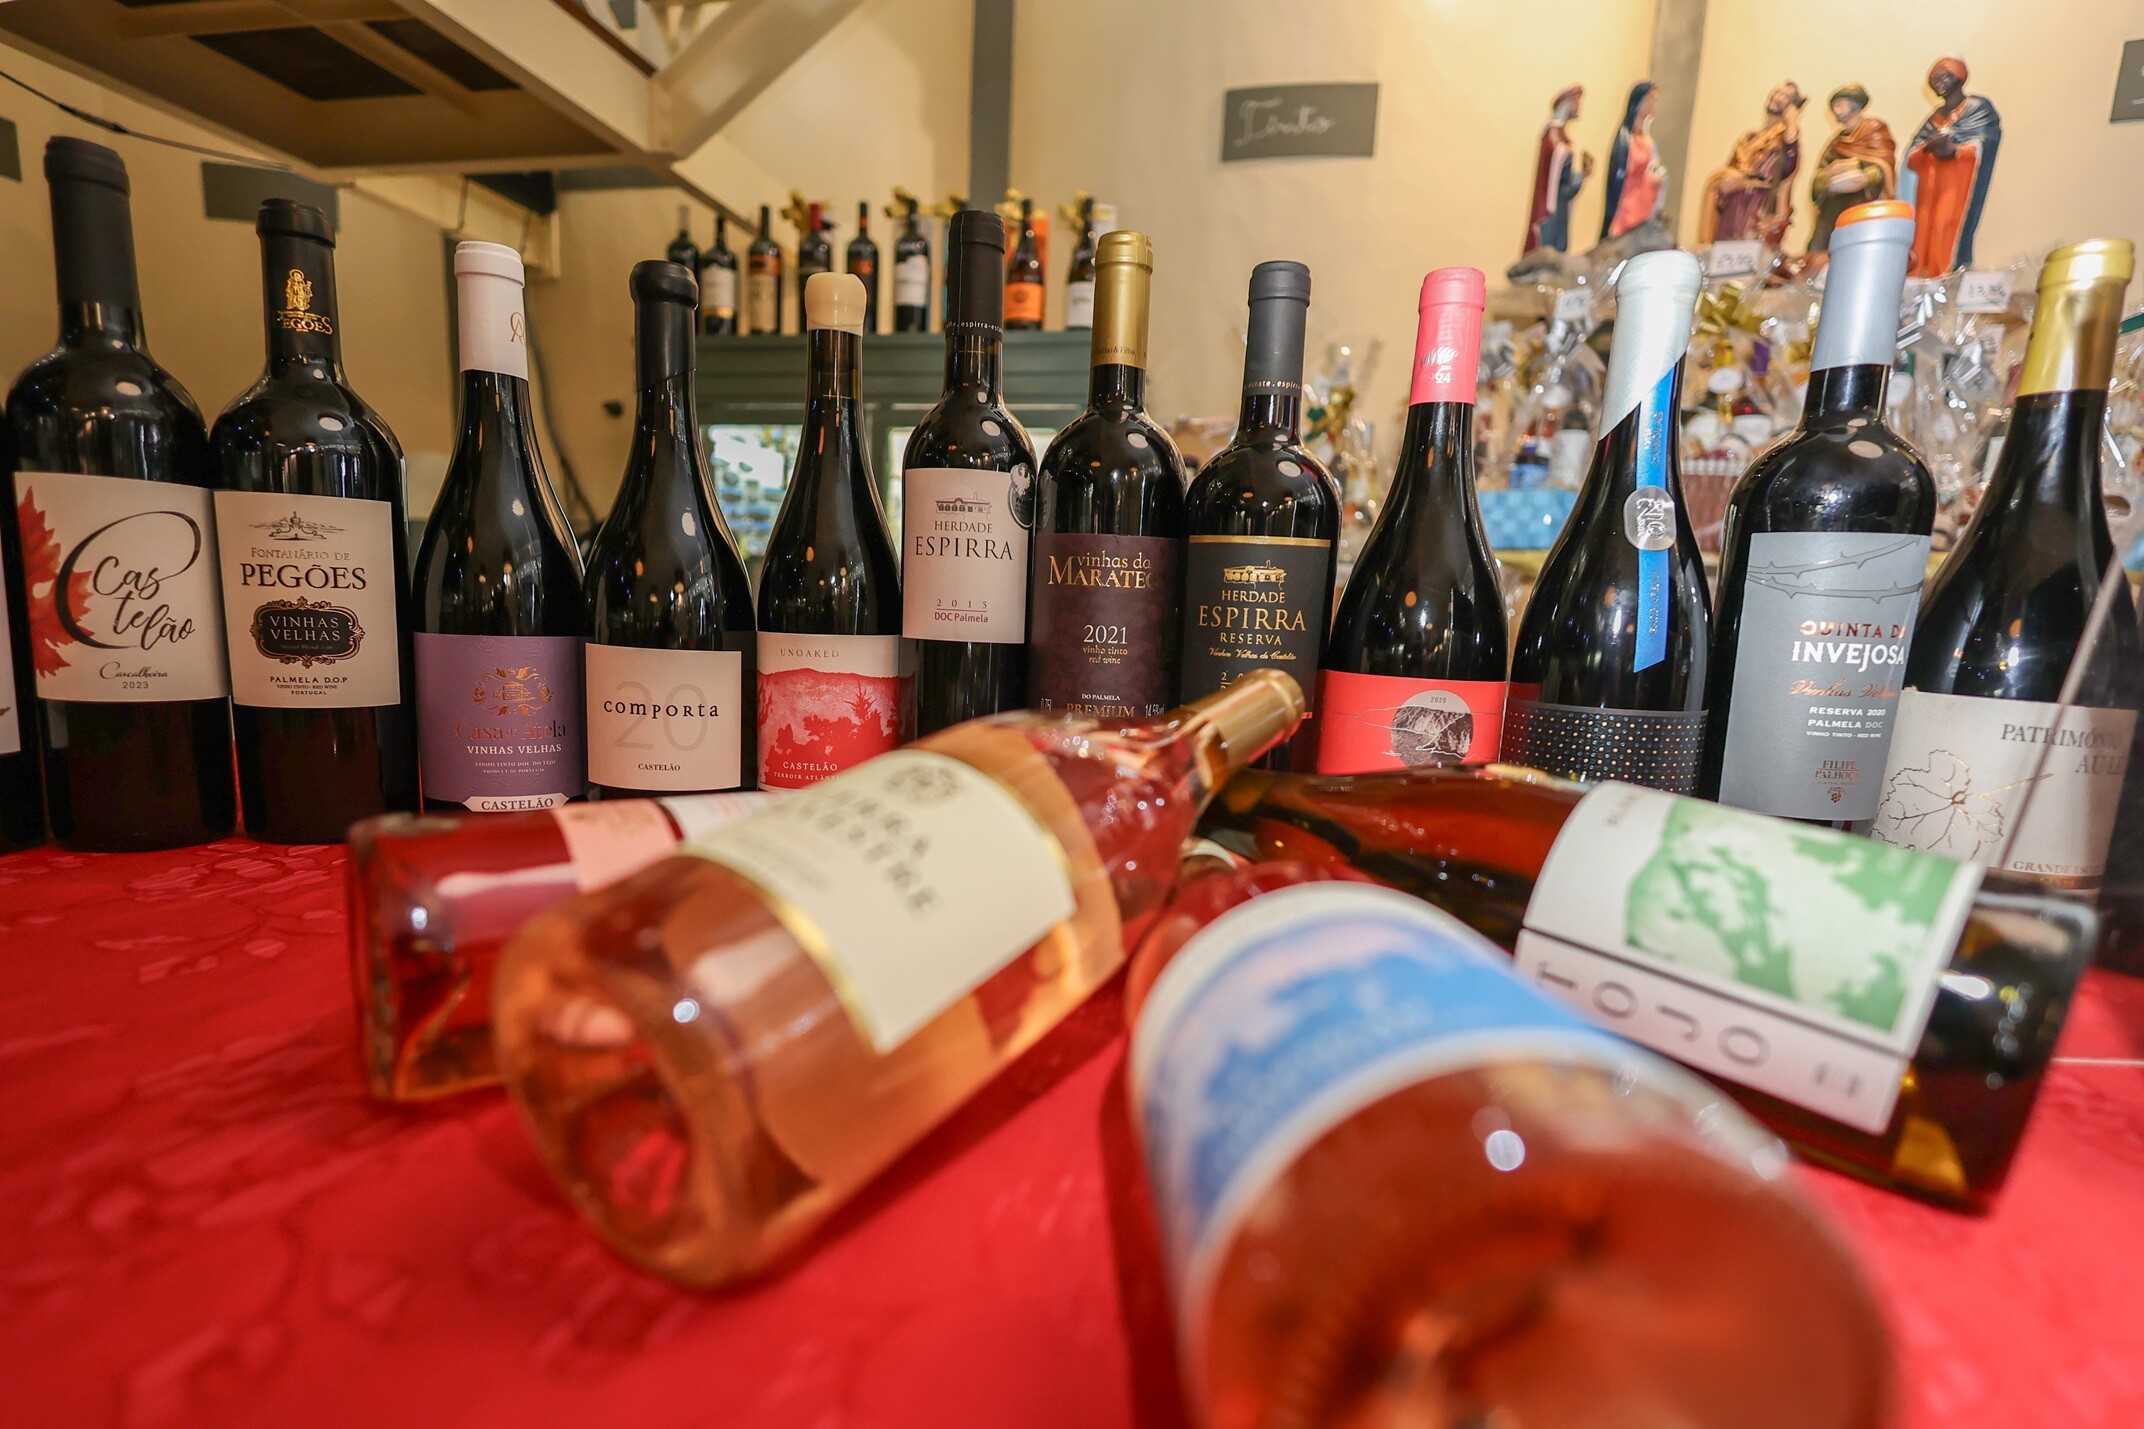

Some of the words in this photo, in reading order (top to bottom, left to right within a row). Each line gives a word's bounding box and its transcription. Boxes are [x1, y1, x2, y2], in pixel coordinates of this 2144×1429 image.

[934, 520, 993, 533] HERDADE
[915, 536, 1013, 560] ESPIRRA
[334, 552, 351, 561] DE
[1077, 550, 1128, 568] vinhas
[240, 563, 367, 590] PEGÕES
[1221, 590, 1286, 603] HERDADE
[936, 599, 987, 609] 2015
[269, 615, 339, 628] VINHAS
[934, 612, 953, 621] DOC
[954, 612, 989, 623] Palmela
[1198, 605, 1307, 631] ESPIRRA
[270, 629, 341, 641] VELHAS
[1083, 624, 1128, 644] 2021
[1800, 620, 1882, 638] QUINTA
[1220, 632, 1282, 645] RESERVA
[780, 648, 840, 658] UNOAKED
[1082, 645, 1106, 655] vinho
[1107, 647, 1128, 656] tinto
[1088, 656, 1102, 664] red
[1102, 656, 1121, 665] wine
[1791, 641, 1905, 673] INVEJOSA
[99, 661, 168, 680] Cascalheira
[122, 681, 149, 689] 2023
[269, 676, 319, 684] PALMELA
[1787, 678, 1853, 698] Vinhas
[1430, 696, 1447, 704] 2020
[614, 680, 709, 752] 20
[1066, 703, 1136, 718] PREMIUM
[1809, 706, 1864, 716] RESERVA
[1866, 708, 1887, 716] 2020
[1807, 719, 1862, 728] PALMELA
[454, 720, 504, 740] Casa
[466, 745, 514, 755] VINHAS
[518, 743, 562, 755] VELHAS
[638, 762, 681, 771] CASTELÃO
[783, 761, 838, 771] CASTELÃO
[1822, 759, 1857, 770] FILIPE
